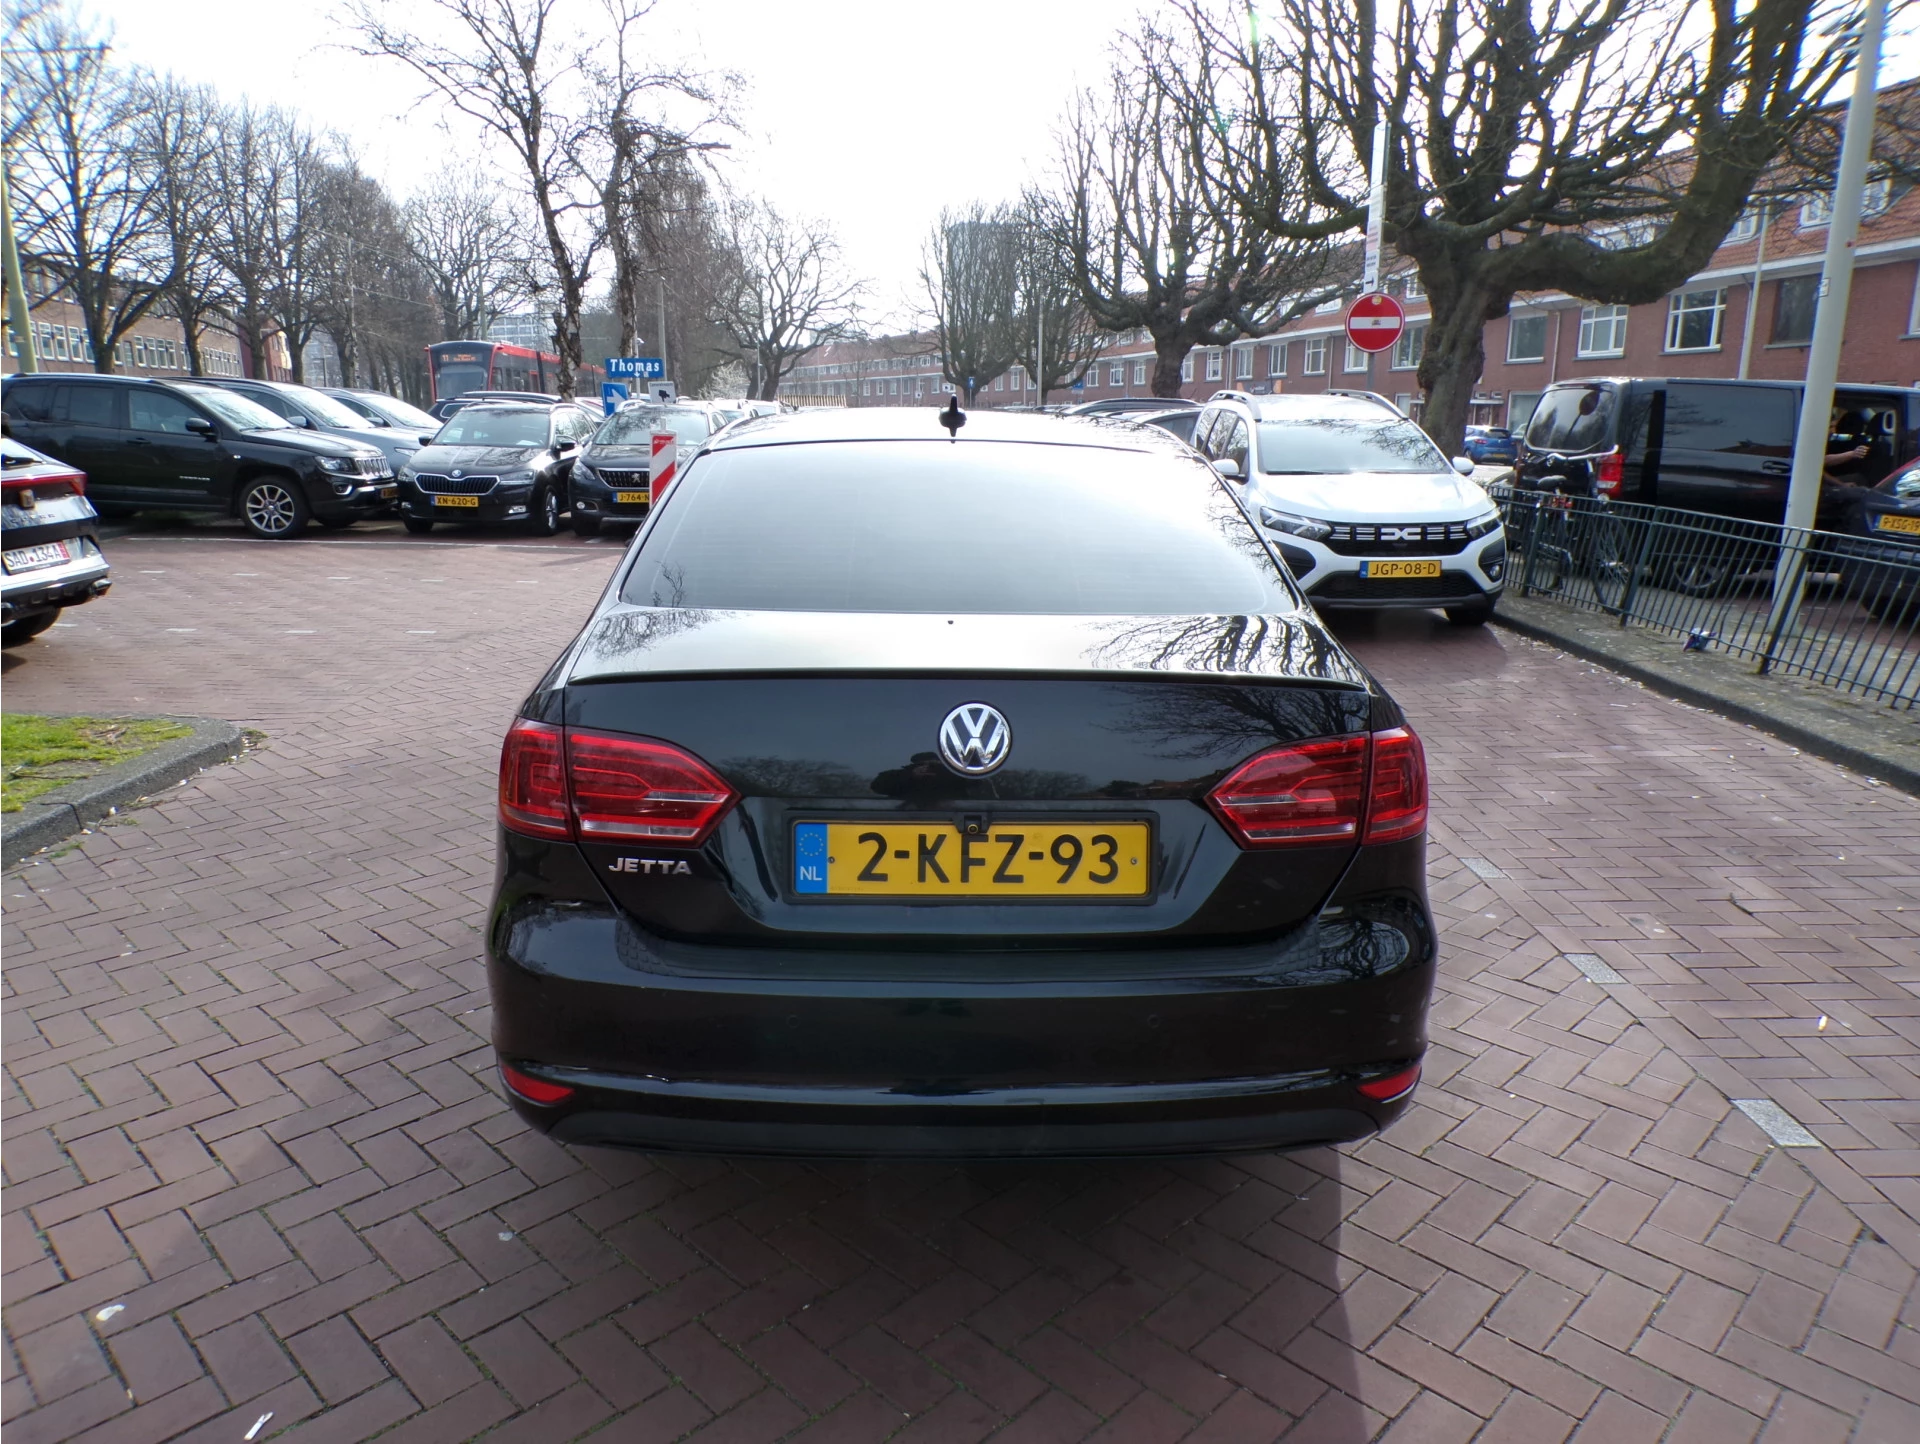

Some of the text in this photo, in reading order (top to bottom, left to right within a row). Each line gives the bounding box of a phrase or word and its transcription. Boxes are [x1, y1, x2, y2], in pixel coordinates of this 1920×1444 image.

[610, 359, 660, 372] Thomas
[436, 496, 476, 506] XN-620-G
[619, 494, 649, 502] J-764-N
[4, 550, 29, 568] SAD
[1372, 563, 1436, 575] JGP-08-D
[857, 832, 1119, 884] 2-KFZ-93
[608, 857, 692, 875] JETTA
[800, 865, 823, 881] NL
